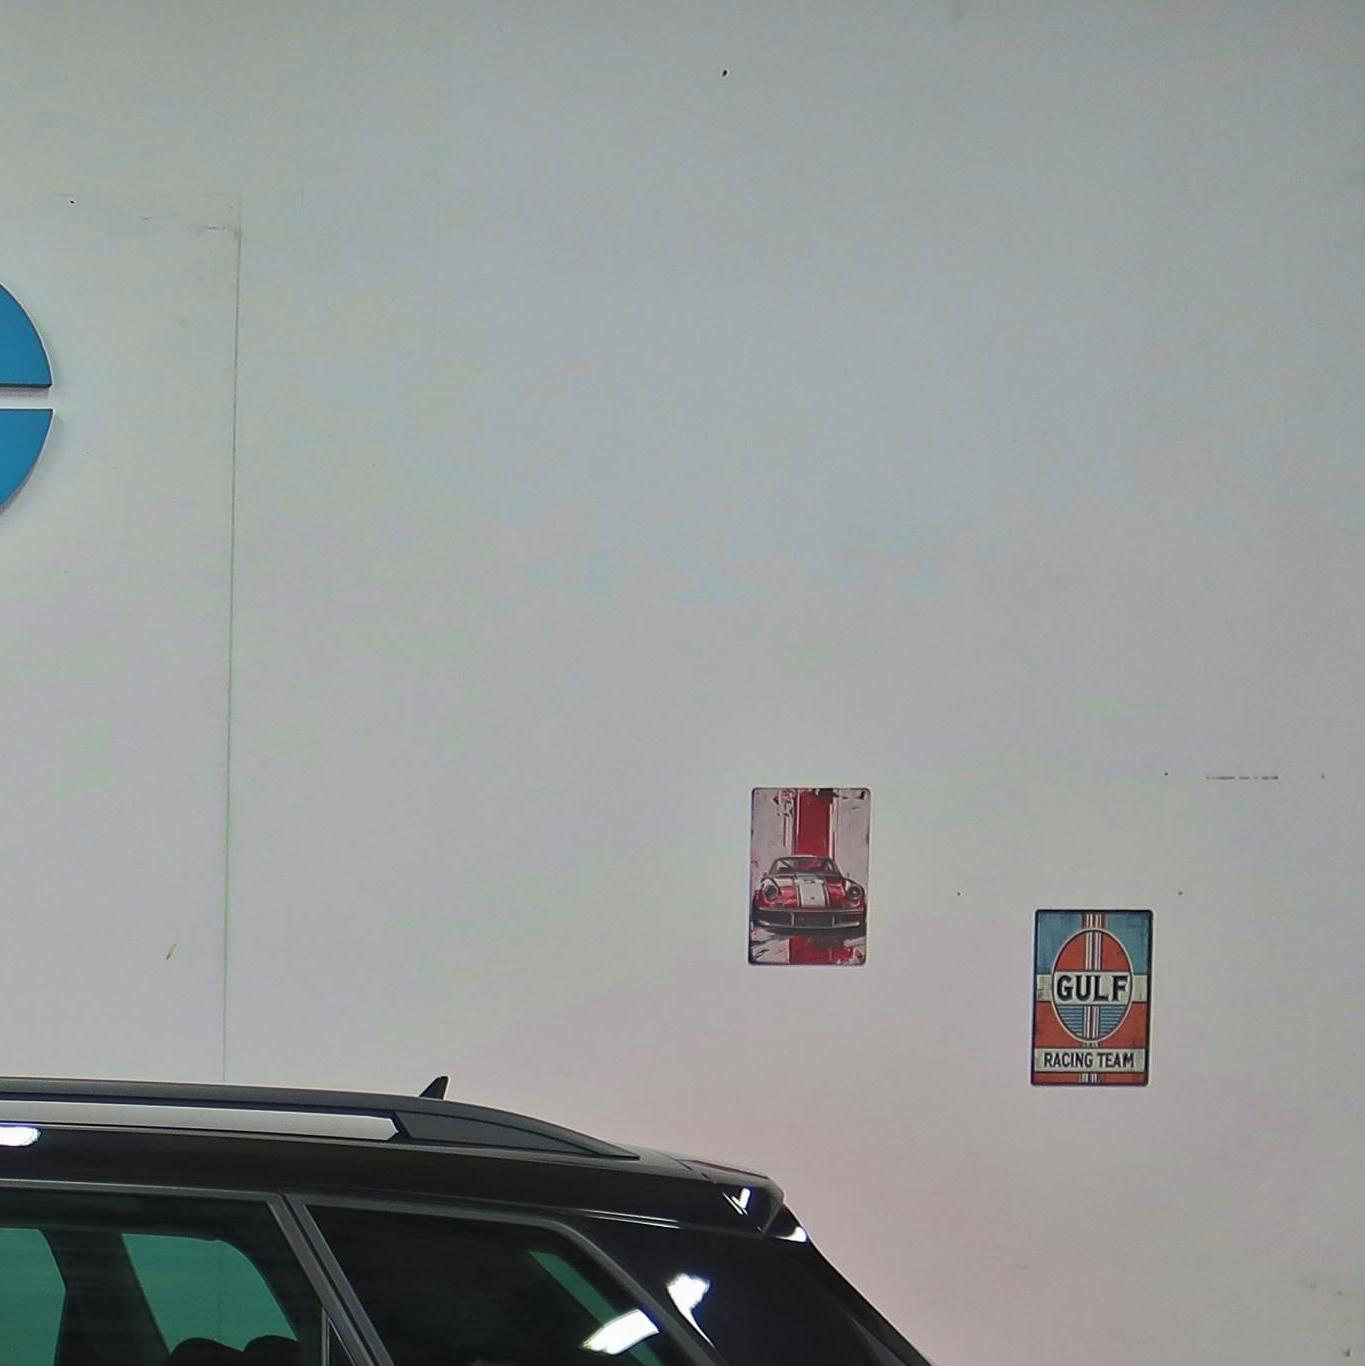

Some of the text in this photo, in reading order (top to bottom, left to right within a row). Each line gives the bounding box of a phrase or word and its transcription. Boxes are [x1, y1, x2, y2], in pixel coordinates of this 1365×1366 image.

[1056, 974, 1129, 1002] GULF
[1043, 1052, 1135, 1069] RACING TEAM
